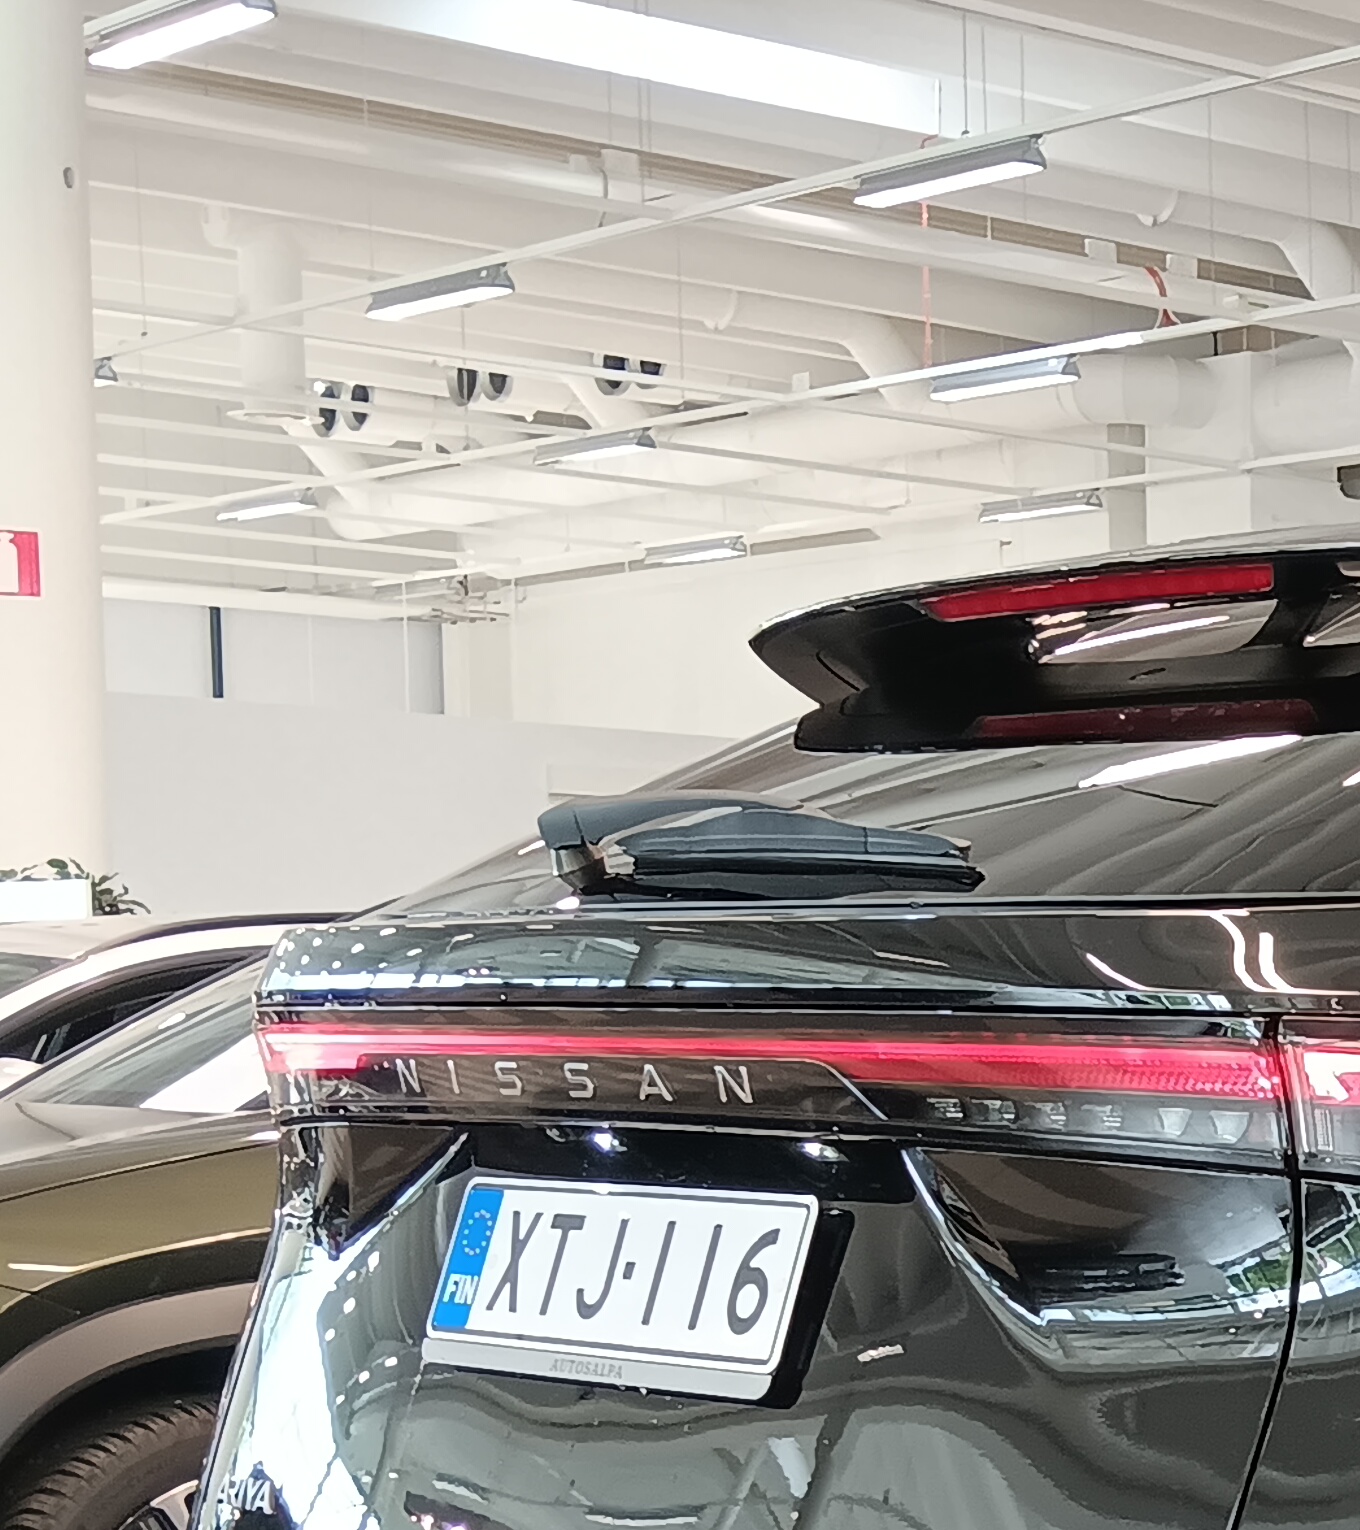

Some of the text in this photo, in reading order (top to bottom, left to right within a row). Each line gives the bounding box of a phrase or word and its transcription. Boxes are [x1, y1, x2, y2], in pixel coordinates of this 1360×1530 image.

[395, 1058, 753, 1104] NISSAN
[442, 1273, 479, 1305] FIN
[486, 1210, 781, 1336] XTJ-116
[549, 1359, 623, 1380] AUTOSALPA
